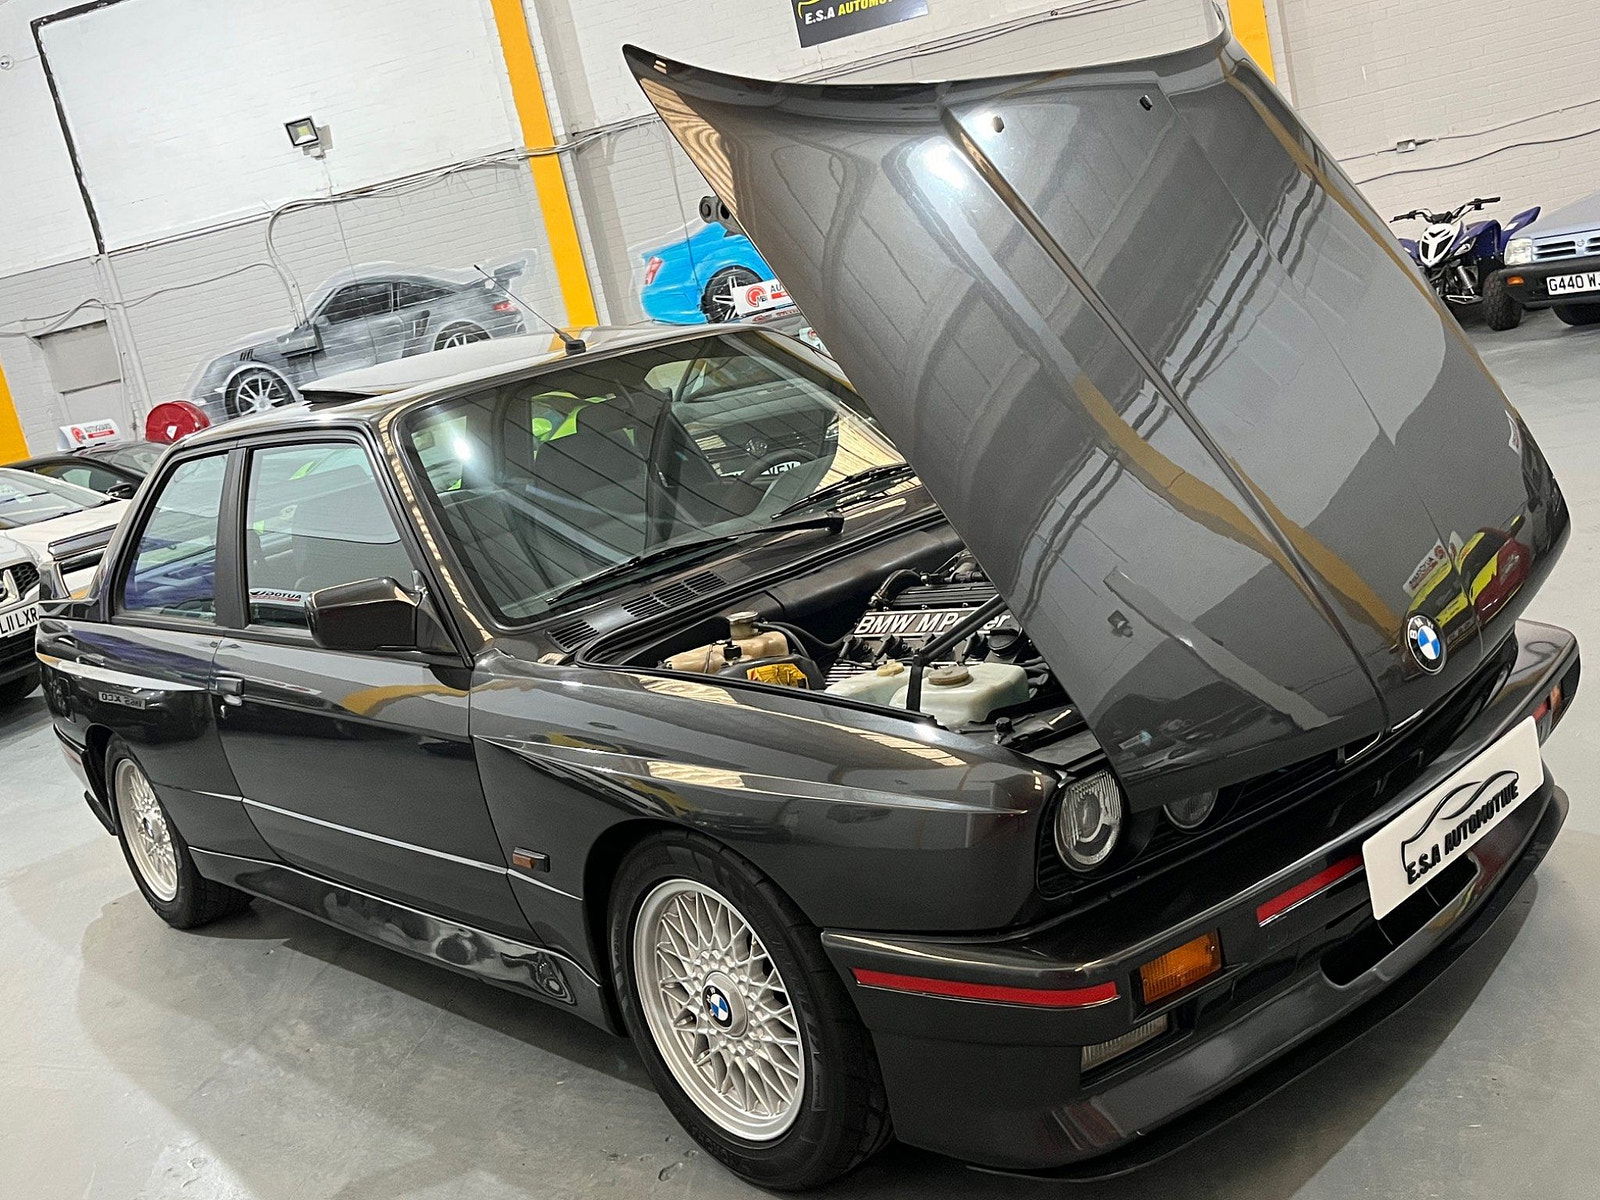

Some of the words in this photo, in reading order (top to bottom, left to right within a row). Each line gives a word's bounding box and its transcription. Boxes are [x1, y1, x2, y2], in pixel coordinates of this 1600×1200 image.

[804, 6, 836, 25] E.S.A
[1549, 275, 1584, 291] G440
[1587, 273, 1600, 288] W
[15, 607, 38, 628] LXR
[854, 614, 916, 635] BMW
[1406, 843, 1442, 886] E.S.A
[1444, 778, 1520, 856] AUTOMOTIVE
